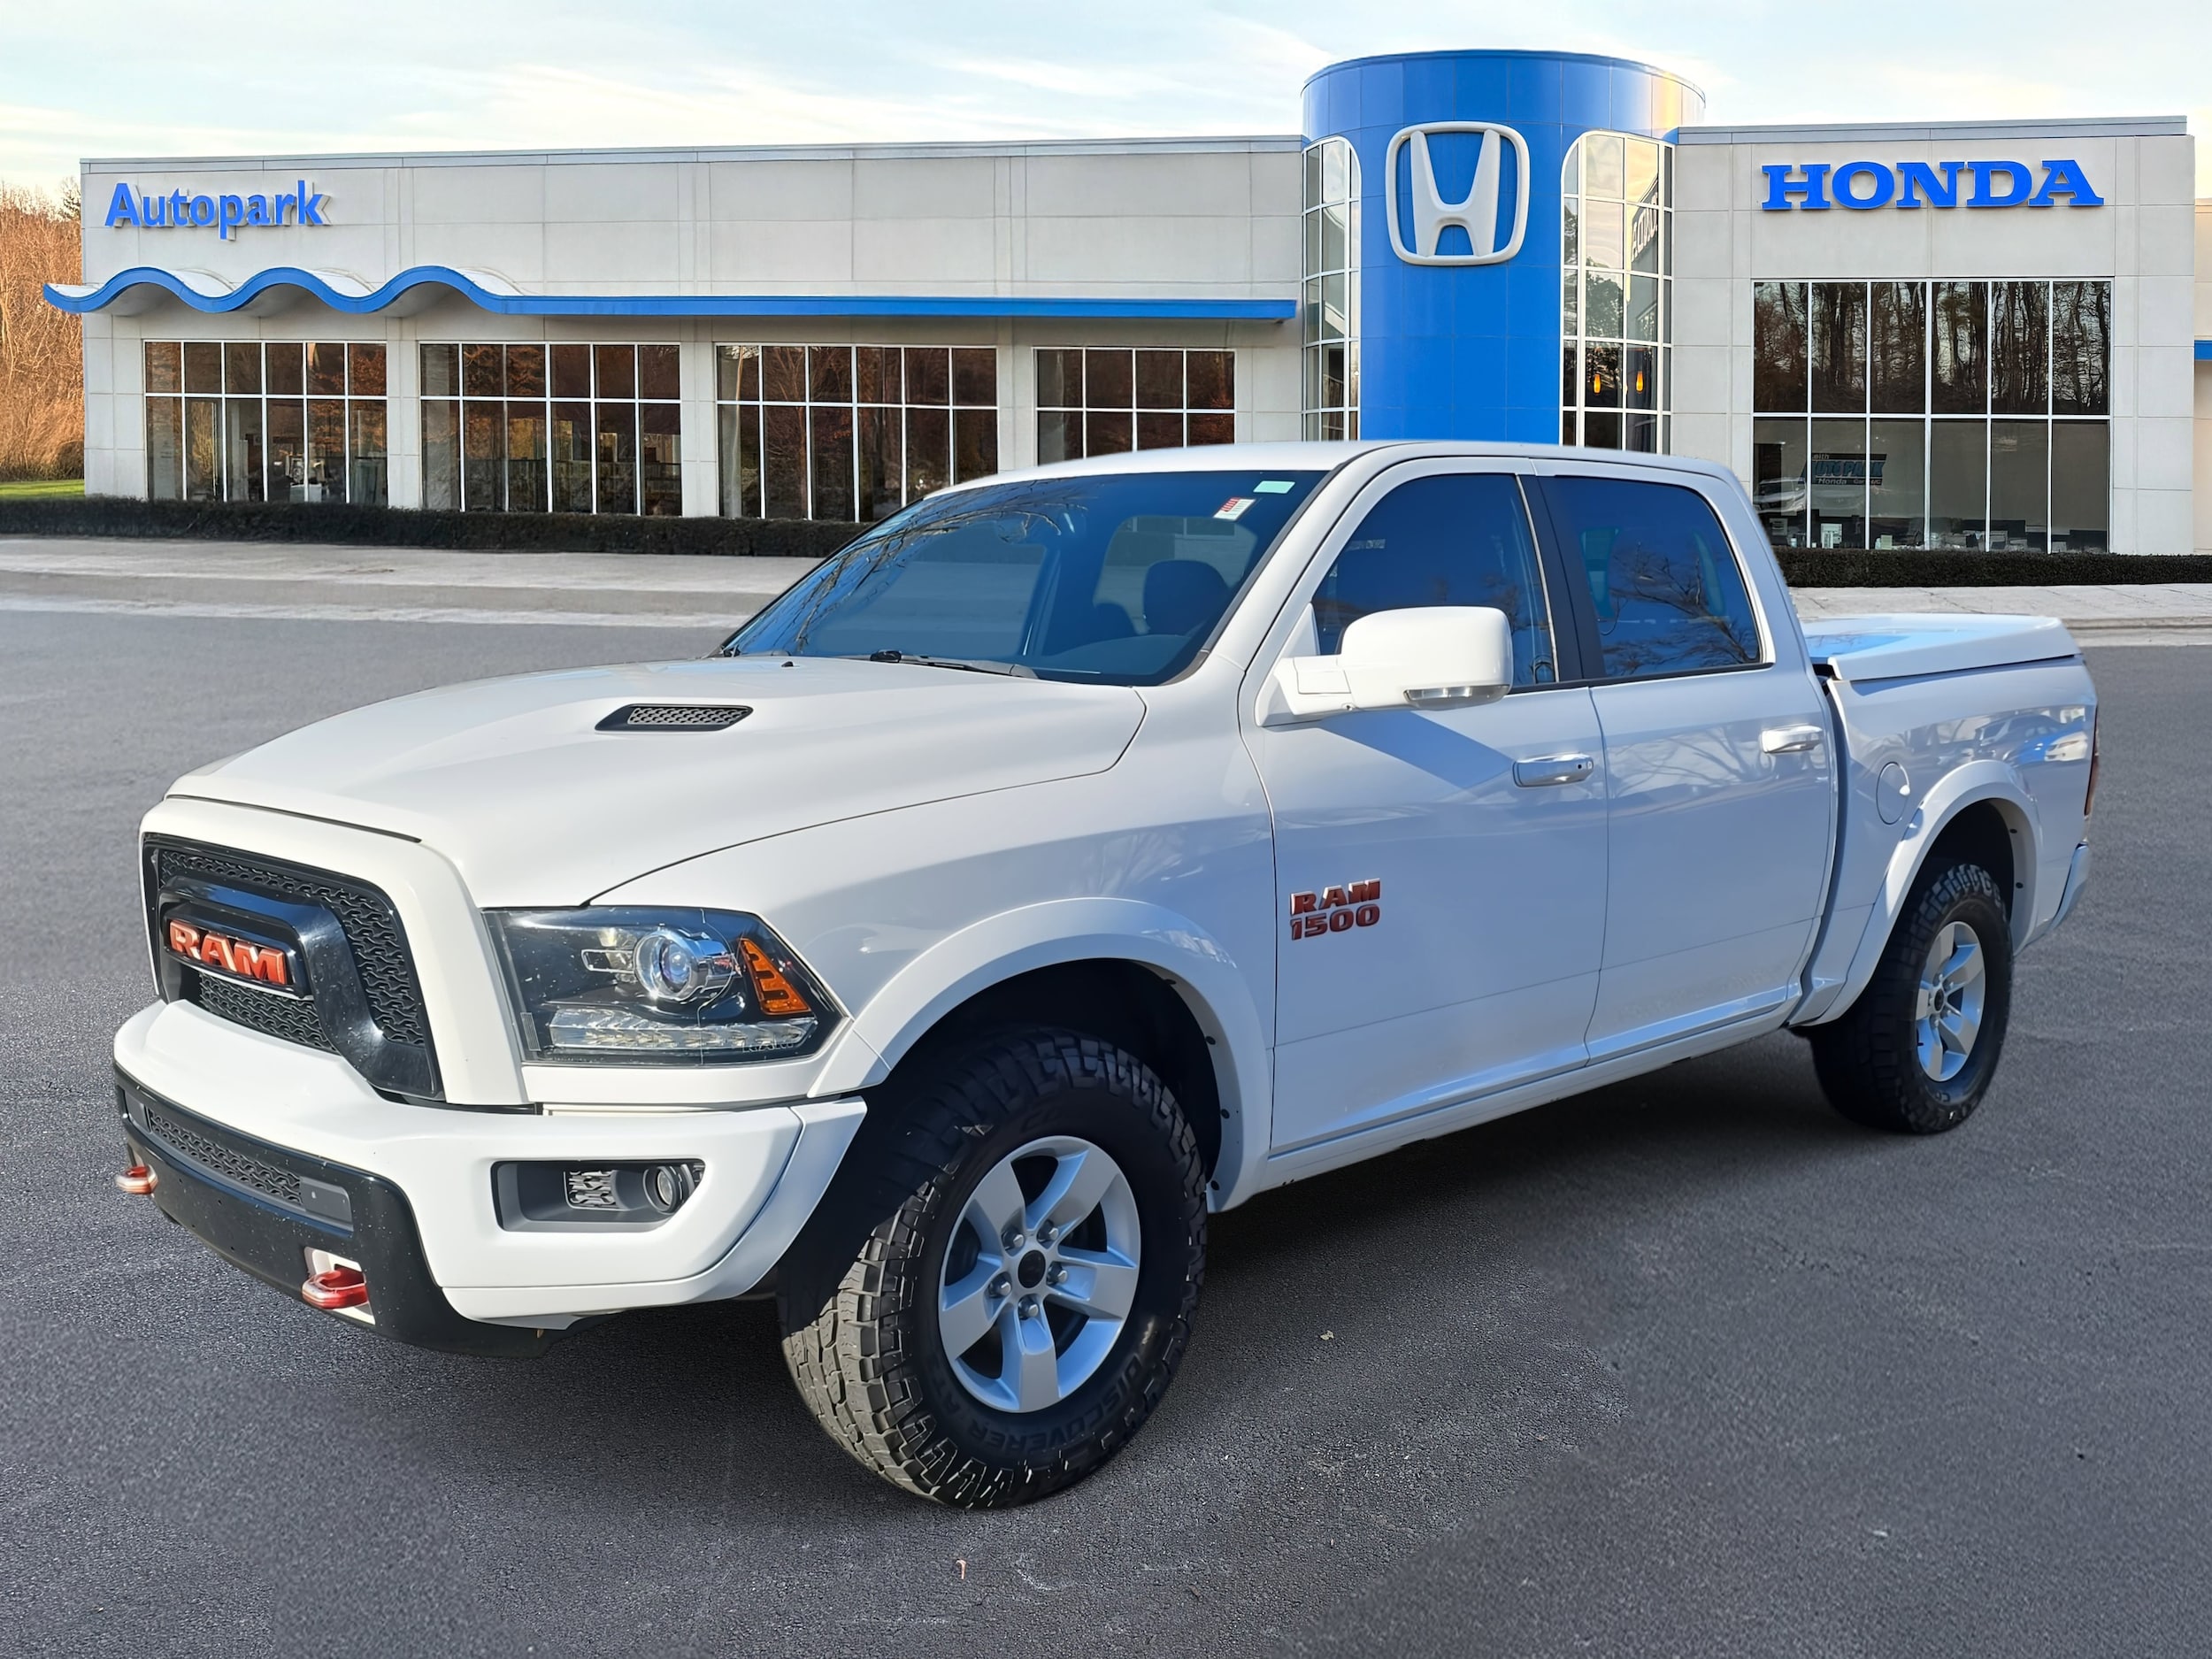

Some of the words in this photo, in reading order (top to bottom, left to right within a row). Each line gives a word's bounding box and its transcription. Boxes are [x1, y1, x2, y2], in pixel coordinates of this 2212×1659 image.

[105, 180, 326, 240] Autopark
[1761, 159, 2105, 211] HONDA
[1290, 878, 1381, 917] RAM
[1290, 903, 1380, 941] 1500
[169, 919, 288, 986] RAM
[968, 1352, 1143, 1455] DISCOVERER
